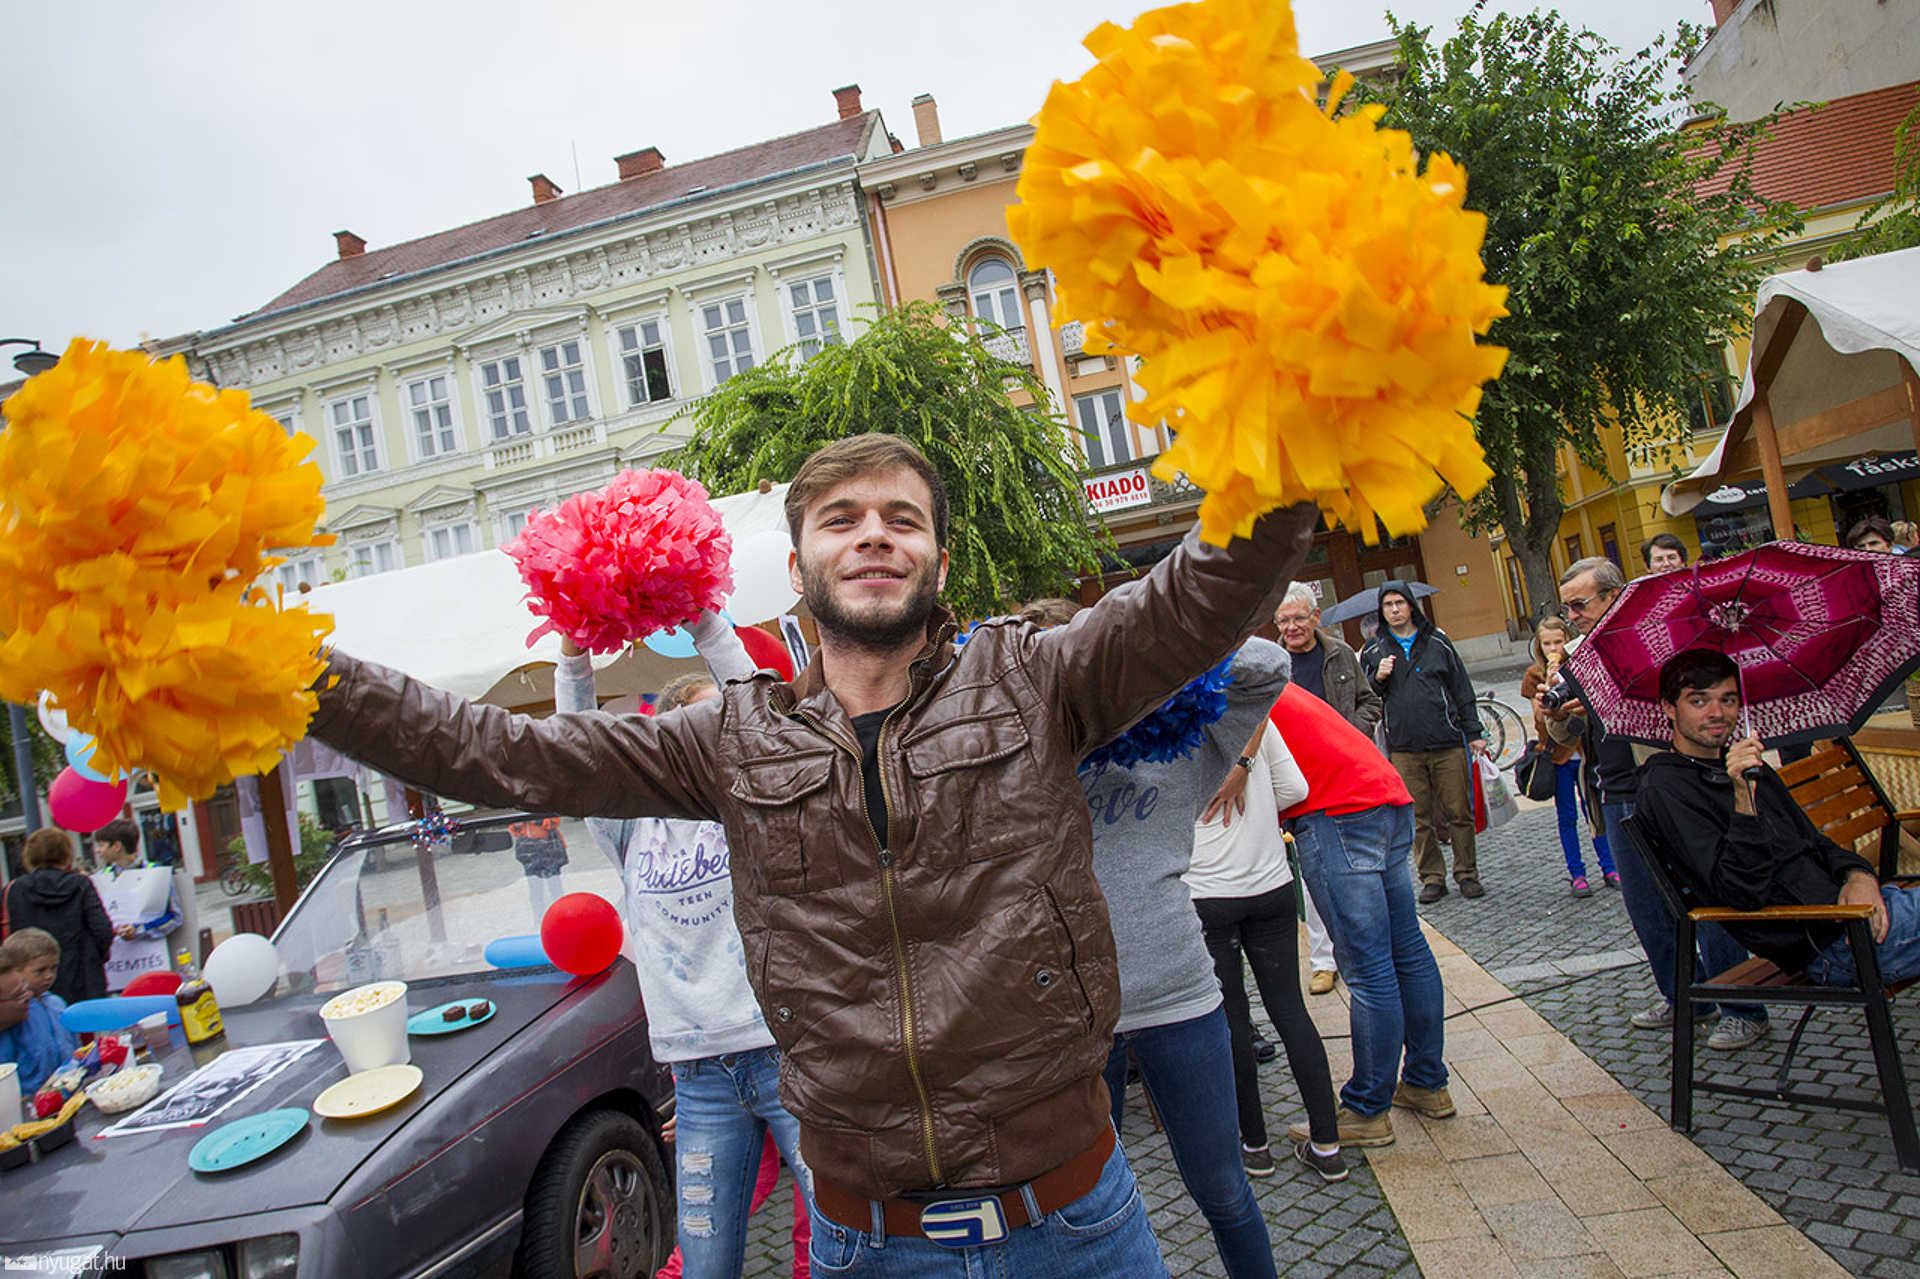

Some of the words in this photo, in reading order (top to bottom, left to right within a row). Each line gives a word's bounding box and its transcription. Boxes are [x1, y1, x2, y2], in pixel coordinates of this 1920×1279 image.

[1086, 470, 1145, 501] KIADÓ
[678, 890, 713, 906] TEEN
[655, 899, 730, 927] COMMUNITY
